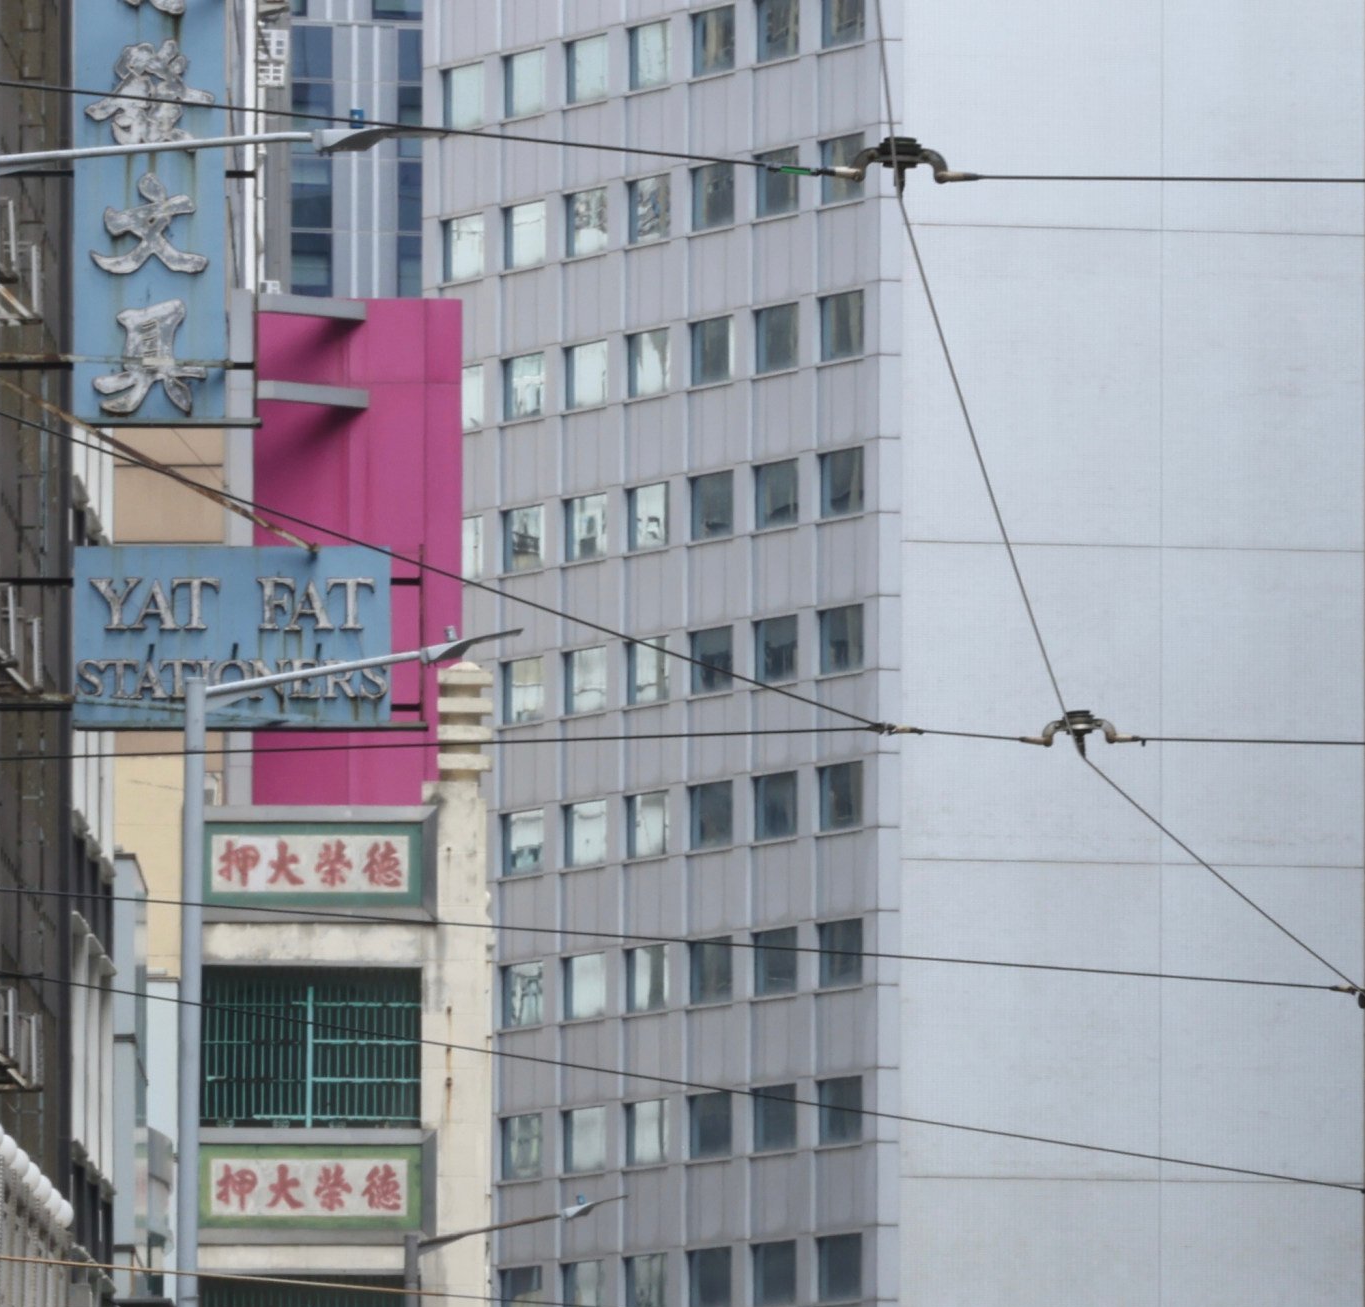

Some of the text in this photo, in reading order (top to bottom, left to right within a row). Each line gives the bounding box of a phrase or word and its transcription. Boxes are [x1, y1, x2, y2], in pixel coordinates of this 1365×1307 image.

[89, 576, 376, 631] YAT FAT
[75, 659, 389, 700] STATIONERS
